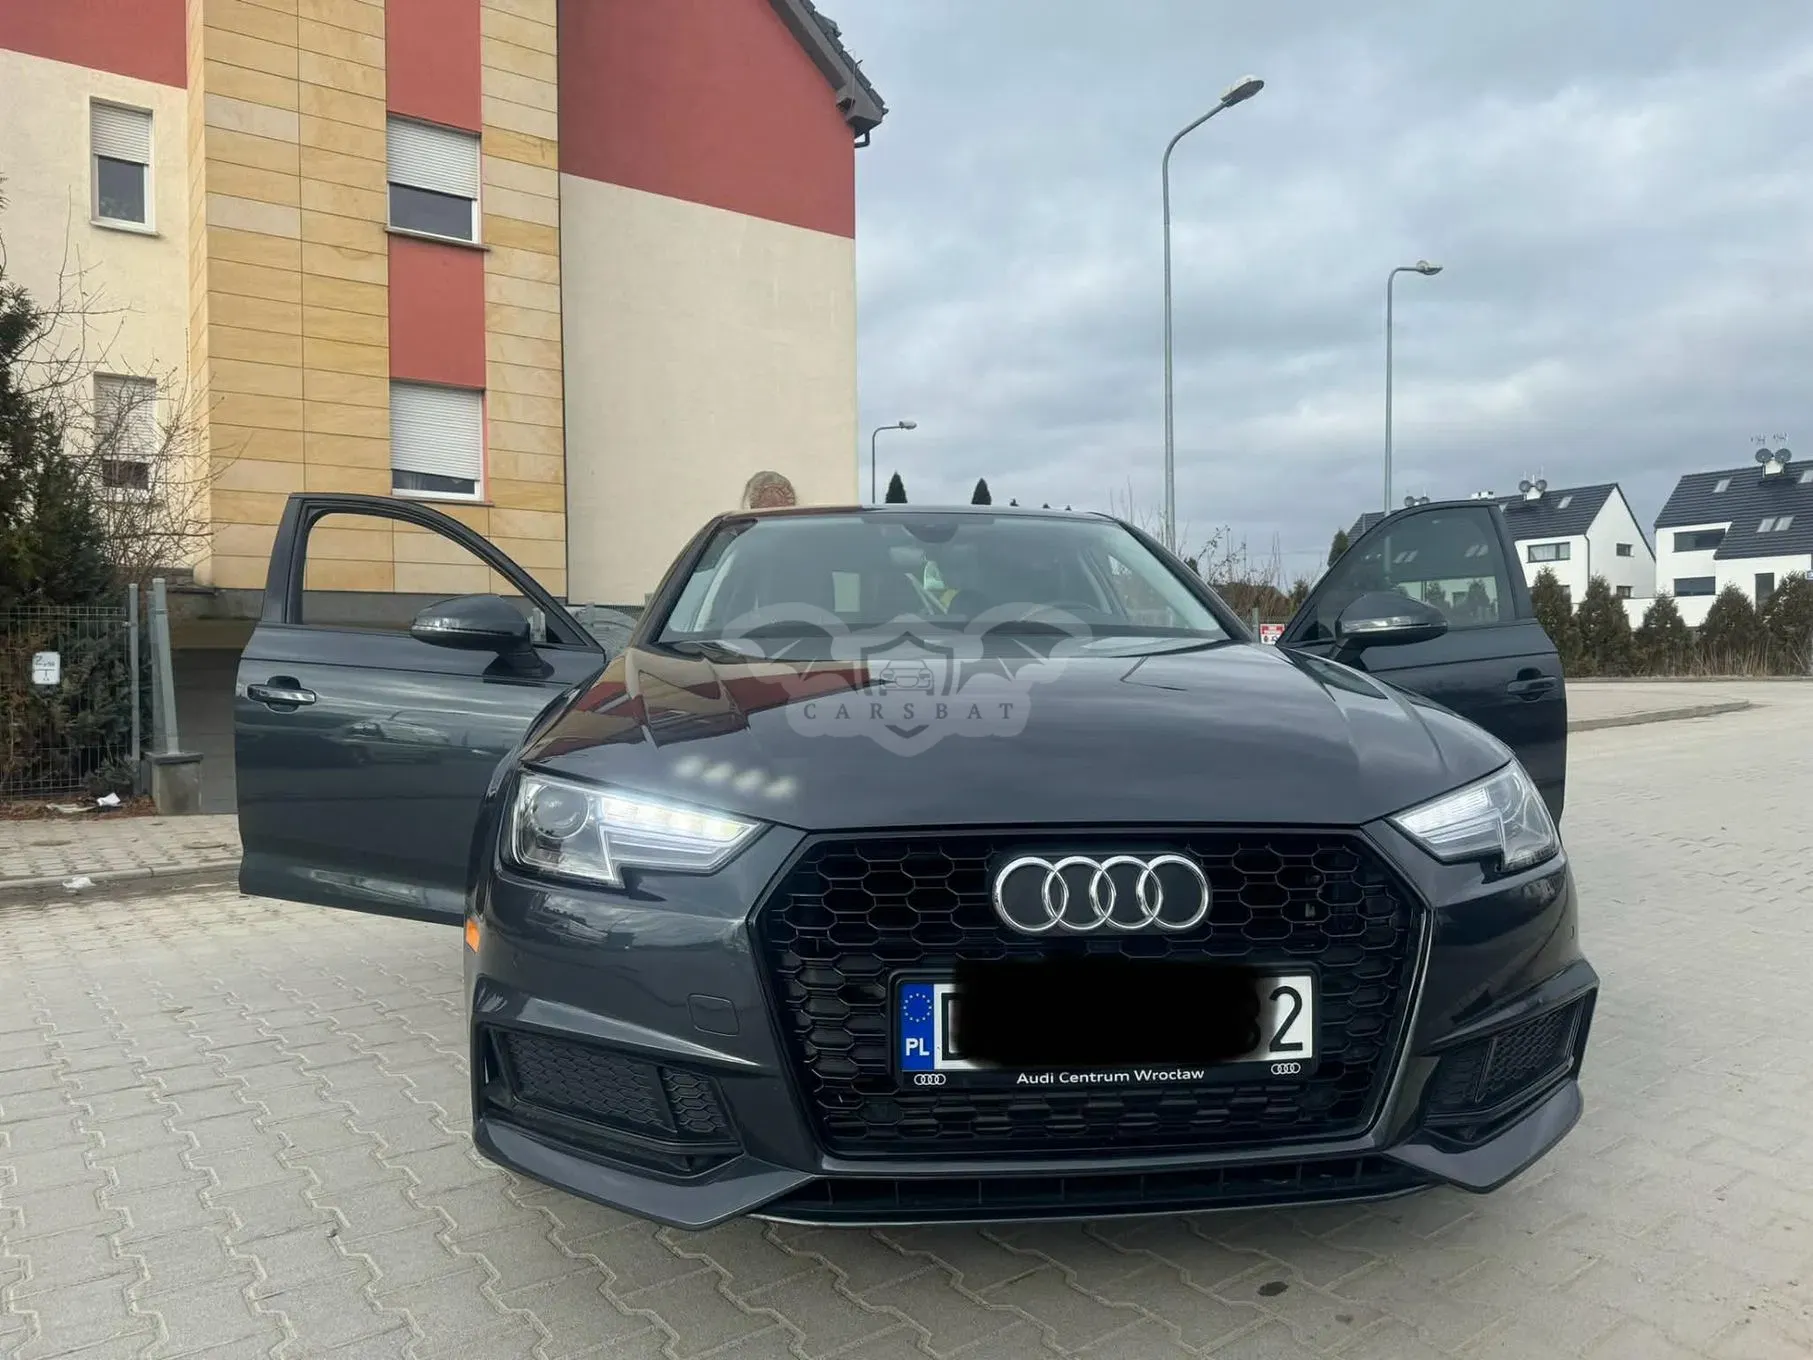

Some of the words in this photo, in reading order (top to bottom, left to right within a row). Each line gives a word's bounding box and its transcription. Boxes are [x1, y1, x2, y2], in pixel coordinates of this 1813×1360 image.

[905, 1037, 930, 1056] PL
[1016, 1072, 1055, 1085] Audi
[1058, 1071, 1130, 1084] Centrum
[1133, 1068, 1205, 1082] Wrocław
